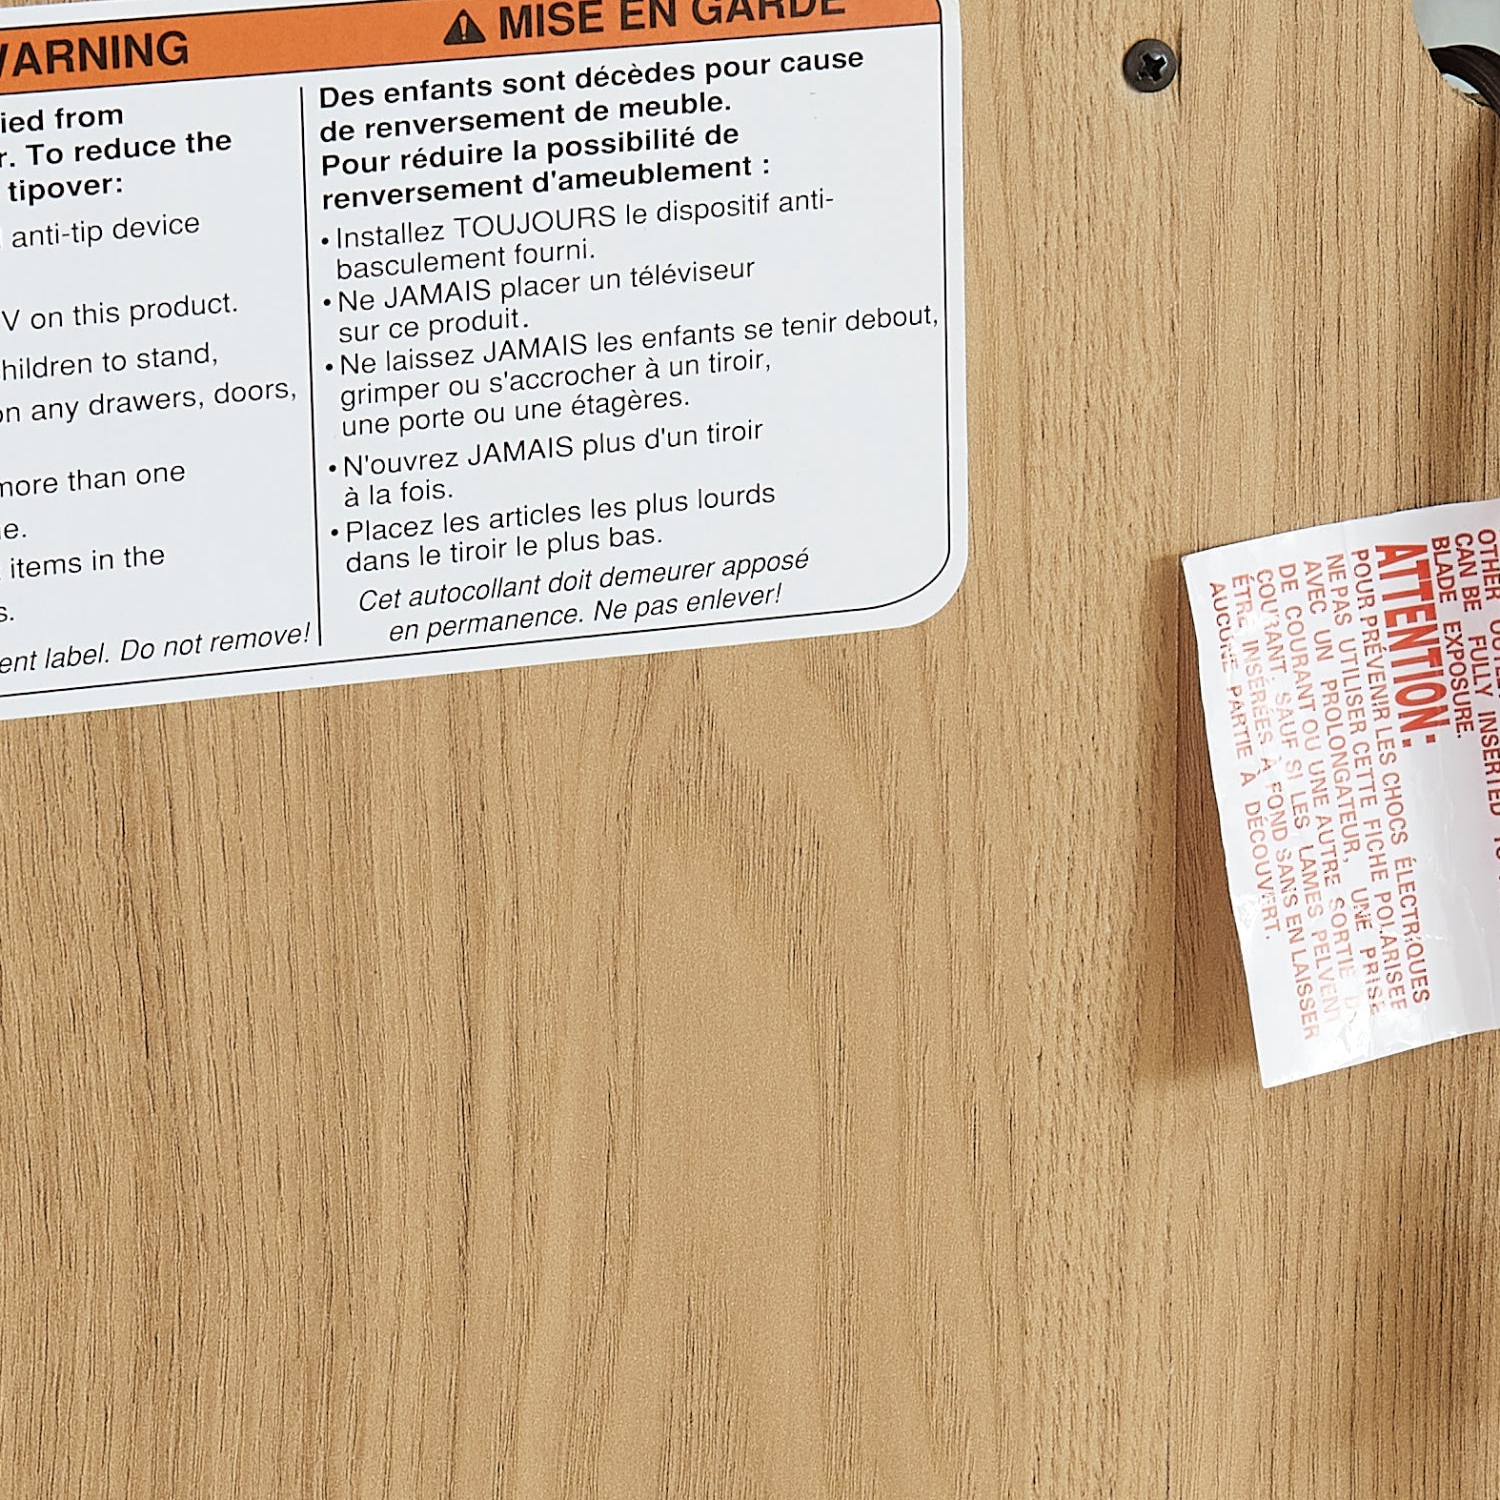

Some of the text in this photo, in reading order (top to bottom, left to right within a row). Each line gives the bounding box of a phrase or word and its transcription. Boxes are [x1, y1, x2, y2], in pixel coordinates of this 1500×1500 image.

[499, 0, 604, 40] MISE
[0, 30, 189, 77] ARNING
[320, 51, 864, 109] Des enfants sont décèdes pour cause
[54, 107, 123, 130] from
[320, 91, 731, 143] de renversement de meuble.
[25, 143, 64, 166] To
[74, 137, 176, 162] reduce
[185, 131, 232, 154] the
[322, 124, 739, 176] Pour réduire la possibilité de
[7, 177, 122, 207] tipover:
[323, 156, 752, 210] renversement d'ameublement
[11, 213, 200, 248] anti-tip device
[337, 187, 834, 249] Installez TOUJOURS le dispositif anti-
[337, 237, 595, 280] basculement fourni.
[30, 293, 237, 330] on this product.
[338, 261, 756, 313] Ne JAMAIS placer un téléviseur
[339, 307, 529, 343] sur ce produit.
[340, 305, 938, 376] Ne laissez JAMAIS les enfants se tenir debout,
[31, 381, 296, 424] any drawers, doors,
[340, 349, 770, 412] grimper ou s'accrocher à un tiroir,
[342, 389, 689, 438] une porte ou une étagères.
[344, 419, 764, 477] N'ouvrez JAMAIS plus d'un tiroir
[344, 478, 453, 508] à la fois.
[346, 482, 775, 543] Placez les articles les plus lourds
[346, 526, 662, 573] dans le tiroir le plus bas.
[1454, 532, 1478, 578] CAN
[359, 547, 809, 612] Cet autocollant doit demeurer apposé
[1350, 548, 1376, 611] POUR
[1461, 585, 1483, 613] BE
[389, 582, 783, 644] en permanence. Ne pas enlever!
[1430, 535, 1475, 739] BLADE EXPOSURE.
[45, 621, 311, 669] label. Do not remove!
[1359, 614, 1391, 722] PRÉVENIR
[1374, 544, 1451, 749] ATTENTION:
[1467, 634, 1494, 697] FULLY
[1374, 725, 1398, 766] LES
[1381, 771, 1409, 846] CHOCS
